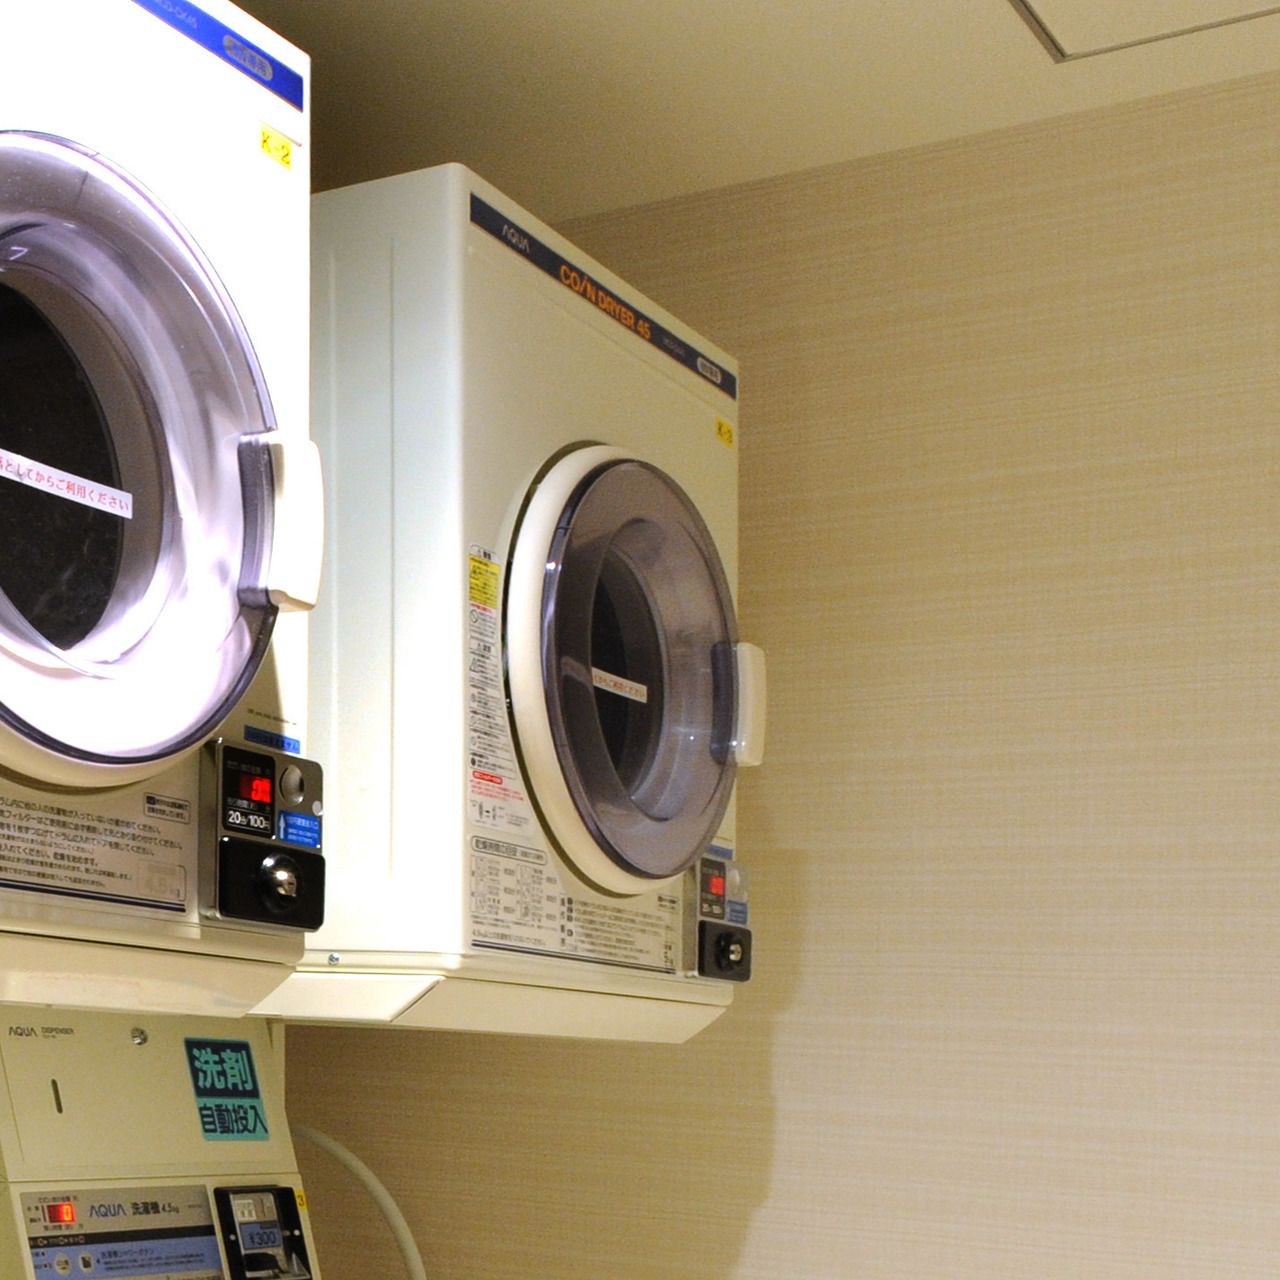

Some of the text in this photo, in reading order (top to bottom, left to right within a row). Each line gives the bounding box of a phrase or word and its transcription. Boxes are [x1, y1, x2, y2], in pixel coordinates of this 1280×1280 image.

[597, 292, 636, 331] DRYER
[636, 319, 653, 341] 45
[192, 1047, 254, 1091] 洗剤
[198, 1103, 269, 1135] 自動投入
[89, 1203, 128, 1218] AQUA
